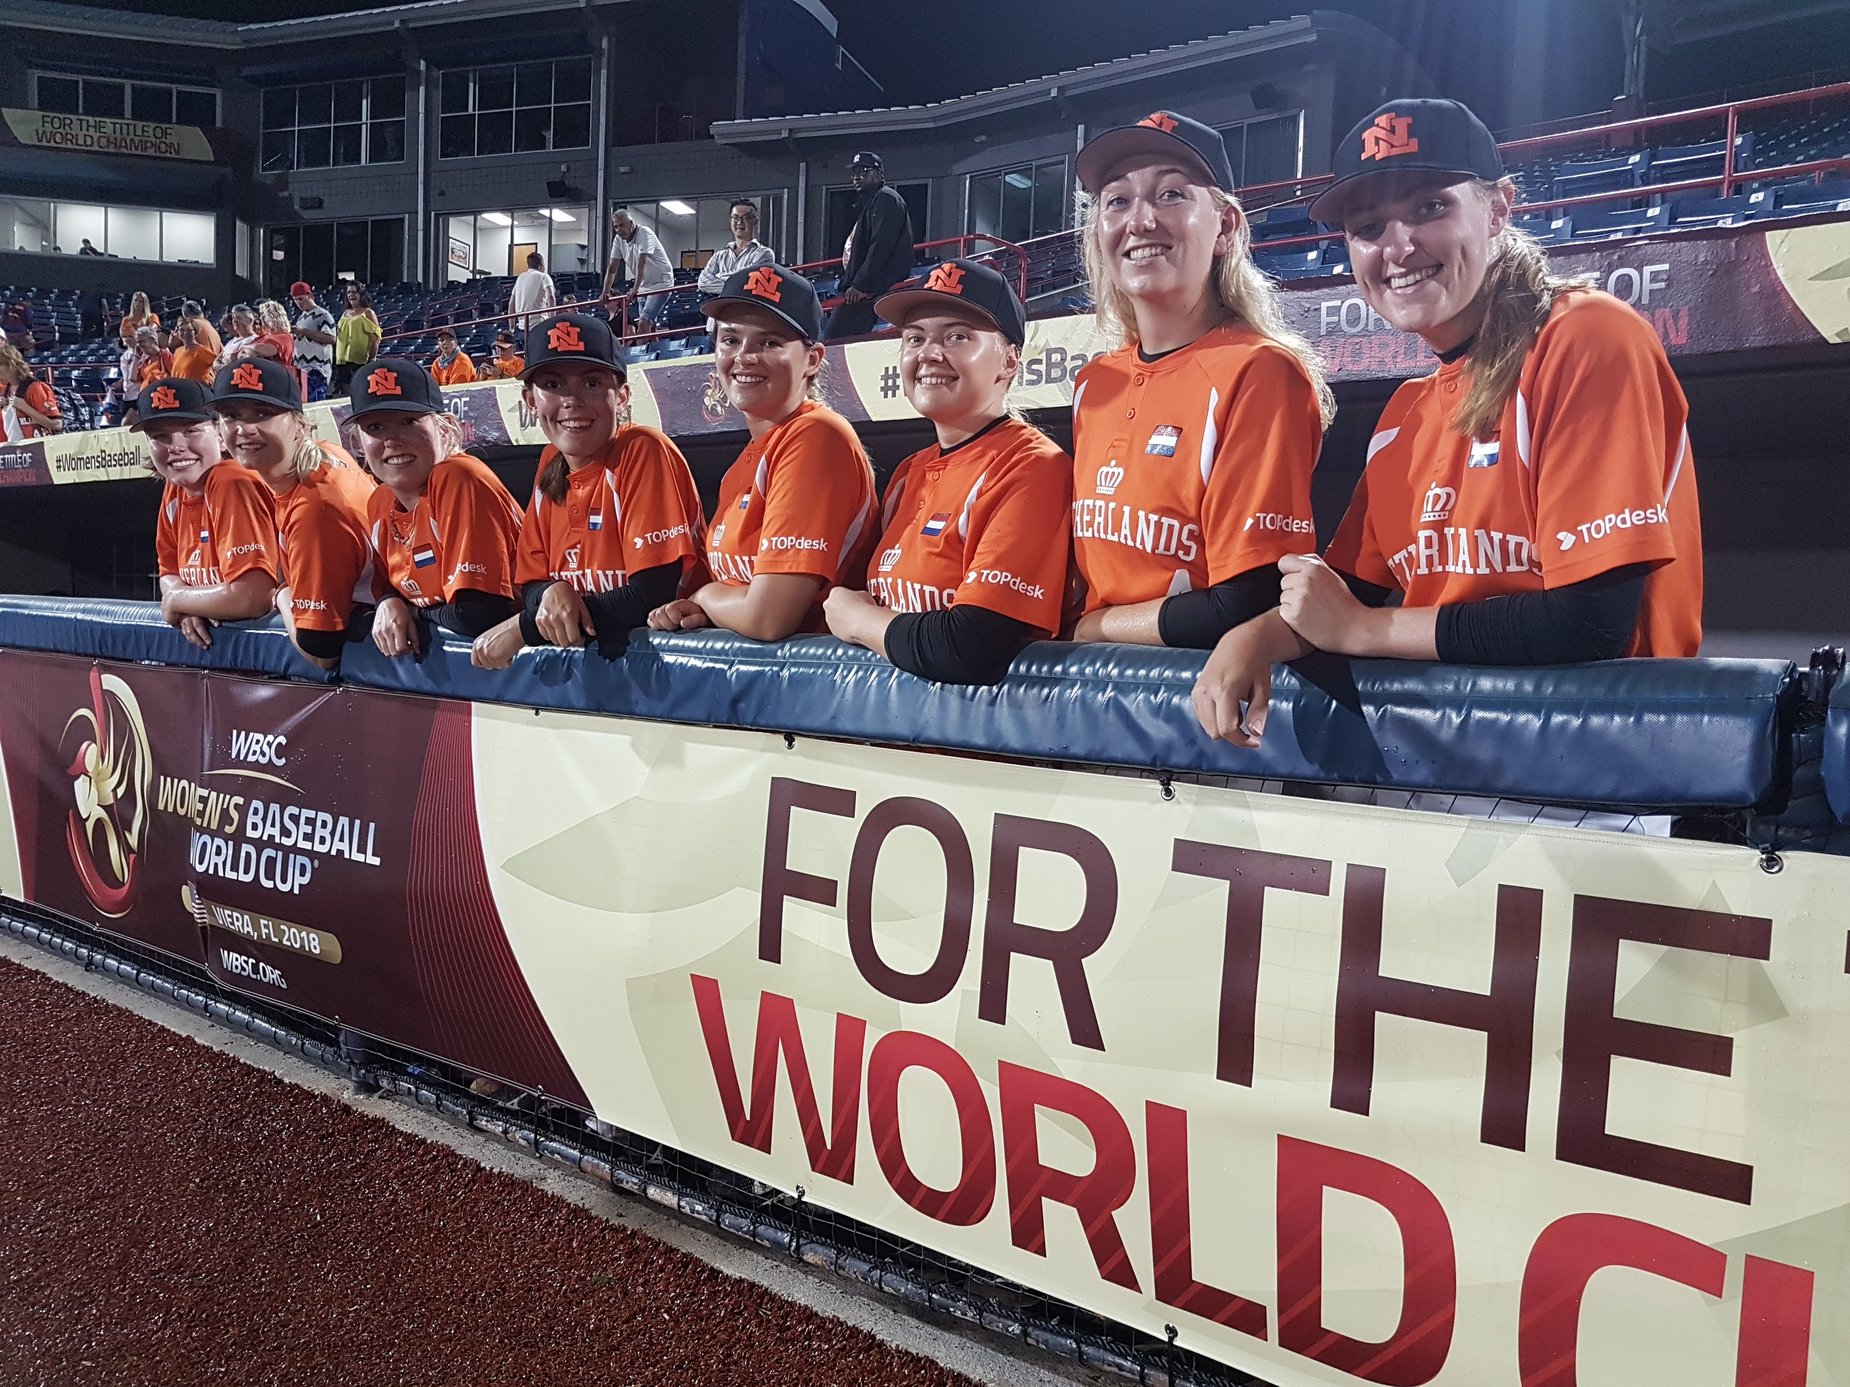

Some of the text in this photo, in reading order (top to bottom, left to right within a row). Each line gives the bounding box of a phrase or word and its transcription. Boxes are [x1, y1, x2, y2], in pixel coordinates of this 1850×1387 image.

[35, 129, 181, 156] WORLD CHAMPION
[42, 114, 173, 140] FOR THE TITLE OF
[1607, 263, 1670, 306] OF
[56, 445, 140, 473] #WomensBaseball
[771, 536, 828, 552] TOPdesk
[1072, 499, 1200, 562] HERLANDS
[1577, 503, 1669, 544] TOPdesk
[980, 569, 1045, 600] TOPdesk
[230, 729, 287, 767] WBSC
[157, 775, 381, 867] WOMEN'S BASEBALL
[189, 827, 257, 883] WORLD
[211, 904, 322, 955] VIERA, FL 2018
[219, 947, 288, 990] WBSC.ORG
[758, 776, 1773, 1206] FOR THE
[689, 973, 1457, 1386] WORLD
